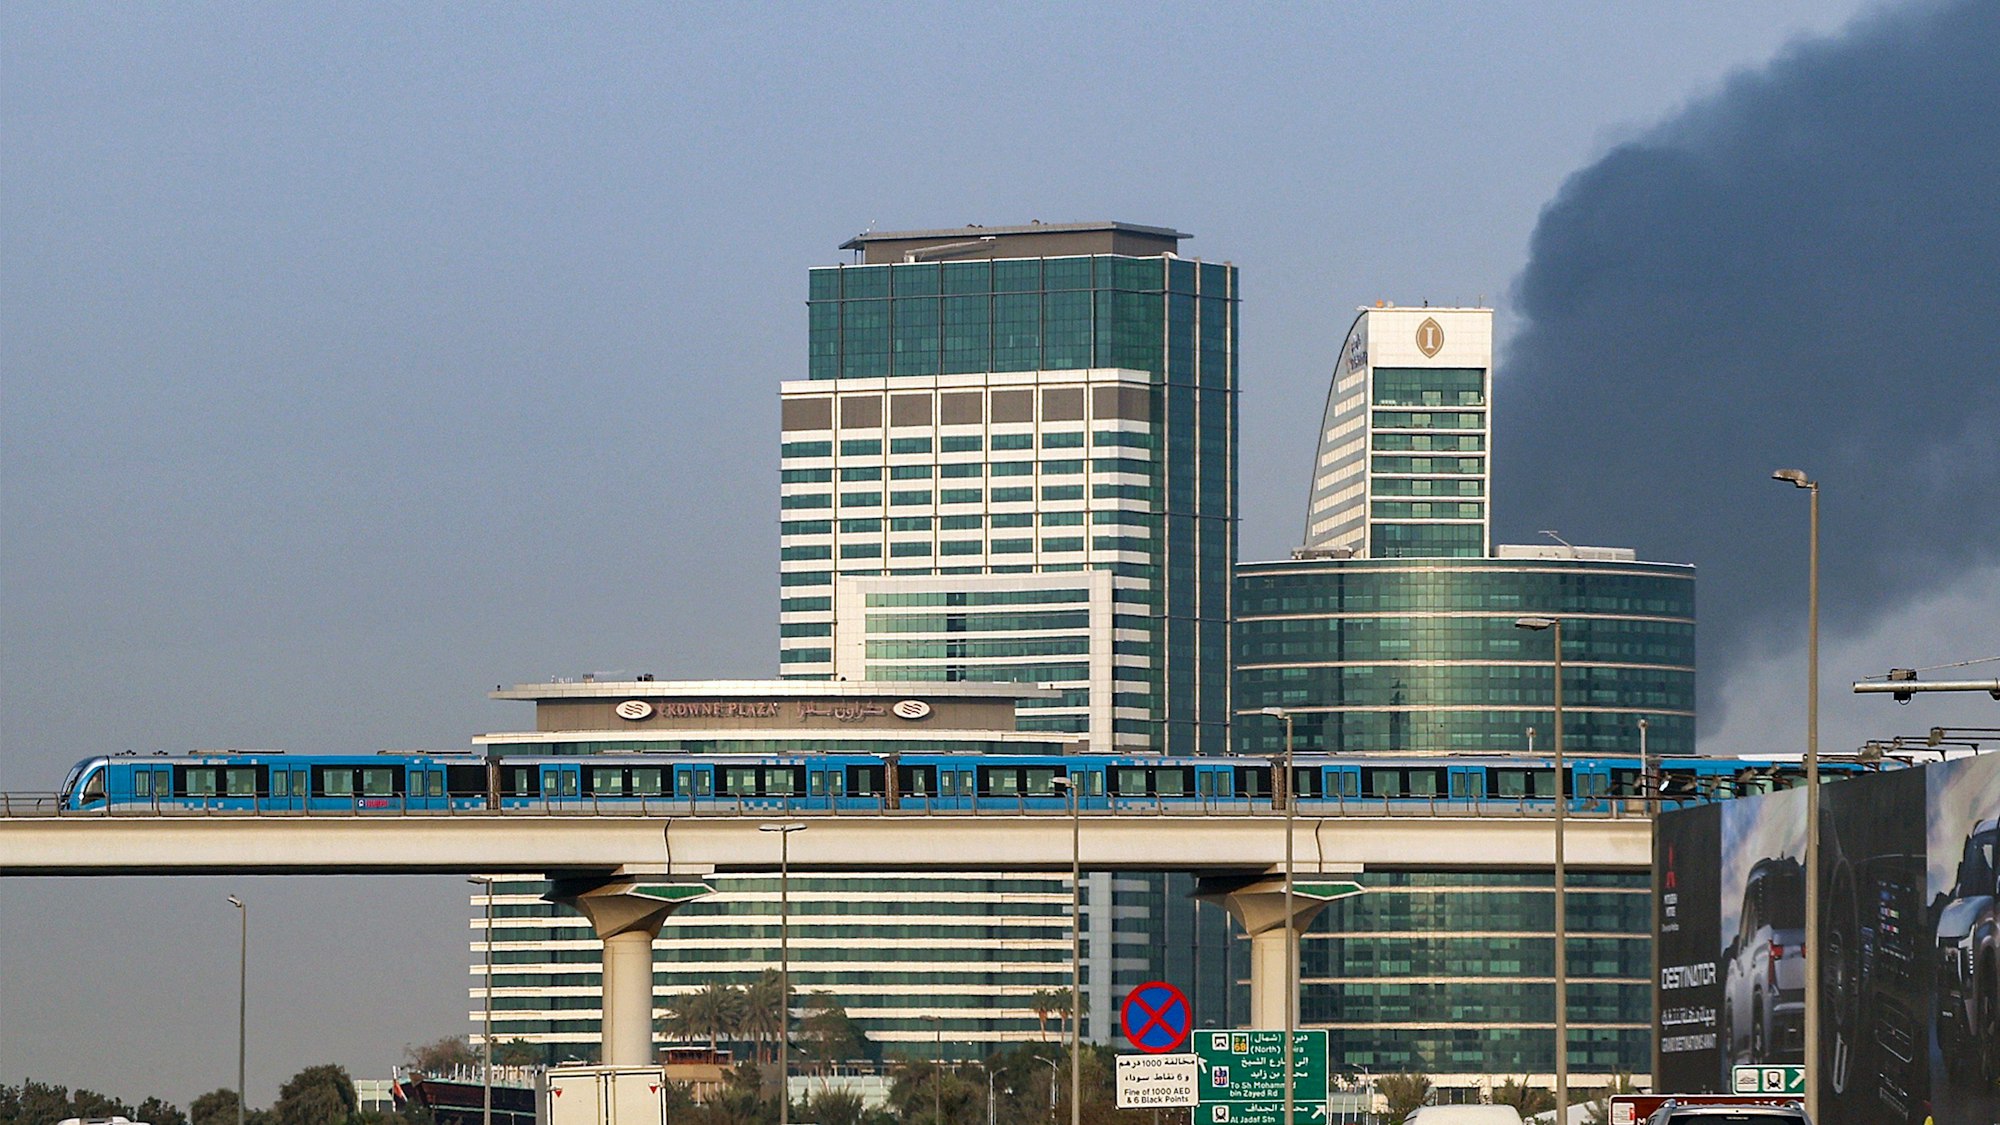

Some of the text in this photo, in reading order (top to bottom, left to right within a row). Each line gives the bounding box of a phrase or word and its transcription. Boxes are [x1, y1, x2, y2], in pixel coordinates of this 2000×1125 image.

[658, 702, 776, 715] CROWNE PLAZA
[1234, 1042, 1246, 1052] 68
[1250, 1045, 1281, 1054] (North)
[1119, 1057, 1195, 1069] مخالفة 1000 درهم
[1241, 1056, 1266, 1067] الشيخ
[1125, 1074, 1149, 1083] سوداء
[1153, 1073, 1175, 1081] نقاط
[1176, 1073, 1183, 1081] 6
[1269, 1071, 1281, 1080] بن
[1214, 1076, 1228, 1085] 311
[1254, 1081, 1297, 1089] Mohammd
[1124, 1087, 1191, 1096] Fine of 1000 AED
[1243, 1090, 1266, 1099] Zayed
[1127, 1096, 1132, 1104] &
[1134, 1096, 1140, 1104] 6
[1141, 1096, 1163, 1104] Black
[1245, 1103, 1278, 1113] الجداف
